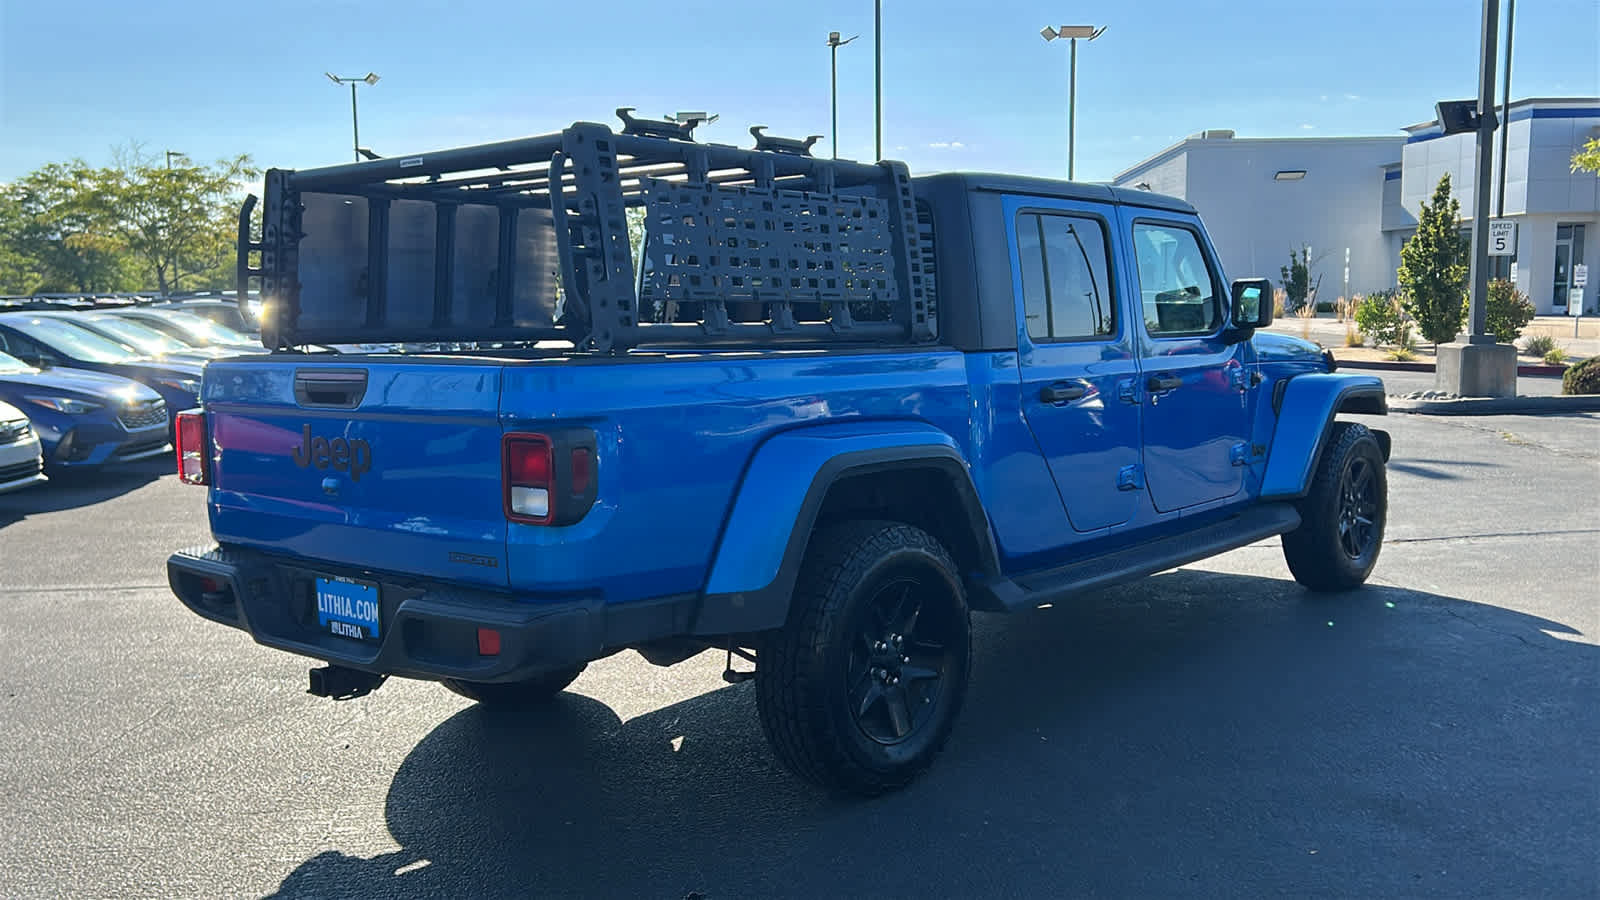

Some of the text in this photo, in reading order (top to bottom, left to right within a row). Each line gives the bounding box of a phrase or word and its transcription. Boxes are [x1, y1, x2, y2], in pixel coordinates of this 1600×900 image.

[1495, 238, 1505, 251] 5
[292, 424, 371, 482] Jeep
[317, 592, 379, 624] LITHIA.COM
[338, 622, 363, 639] LITHIA
